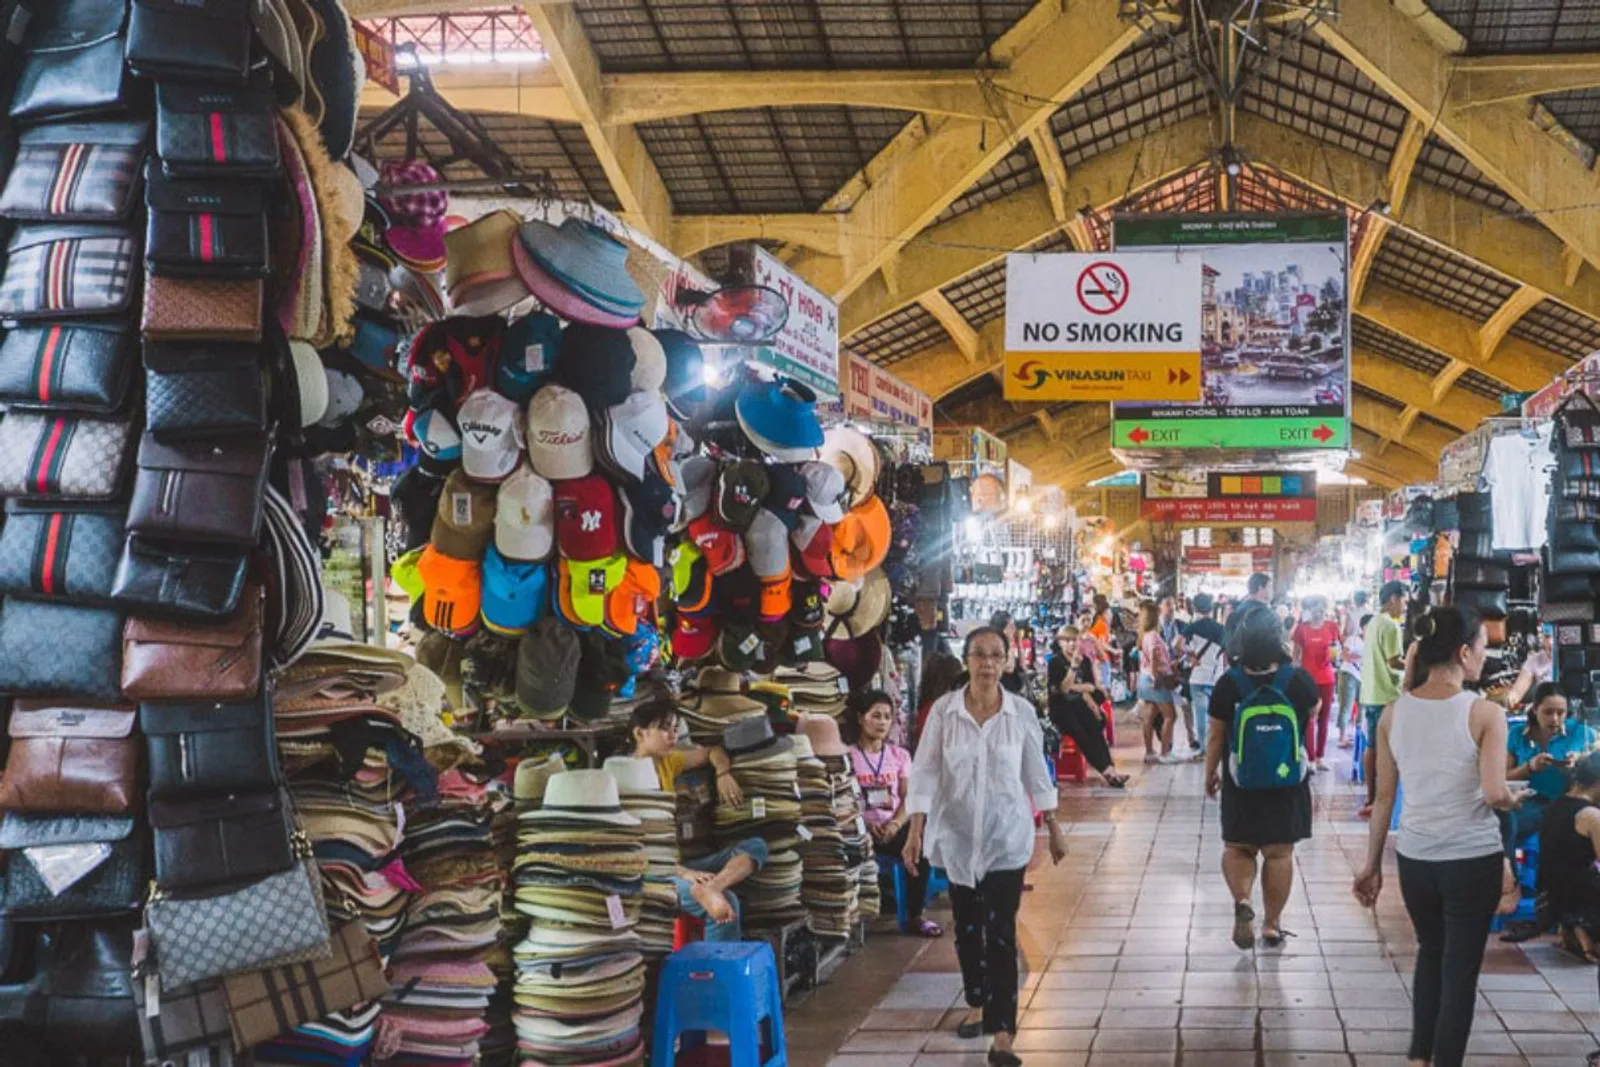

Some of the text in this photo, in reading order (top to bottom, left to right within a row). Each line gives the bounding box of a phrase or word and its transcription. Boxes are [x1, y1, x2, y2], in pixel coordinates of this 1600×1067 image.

[1023, 322, 1183, 343] NO SMOKING
[1054, 369, 1151, 382] VINASUN TAXI
[1151, 428, 1181, 442] EXIT
[1279, 427, 1309, 441] EXIT
